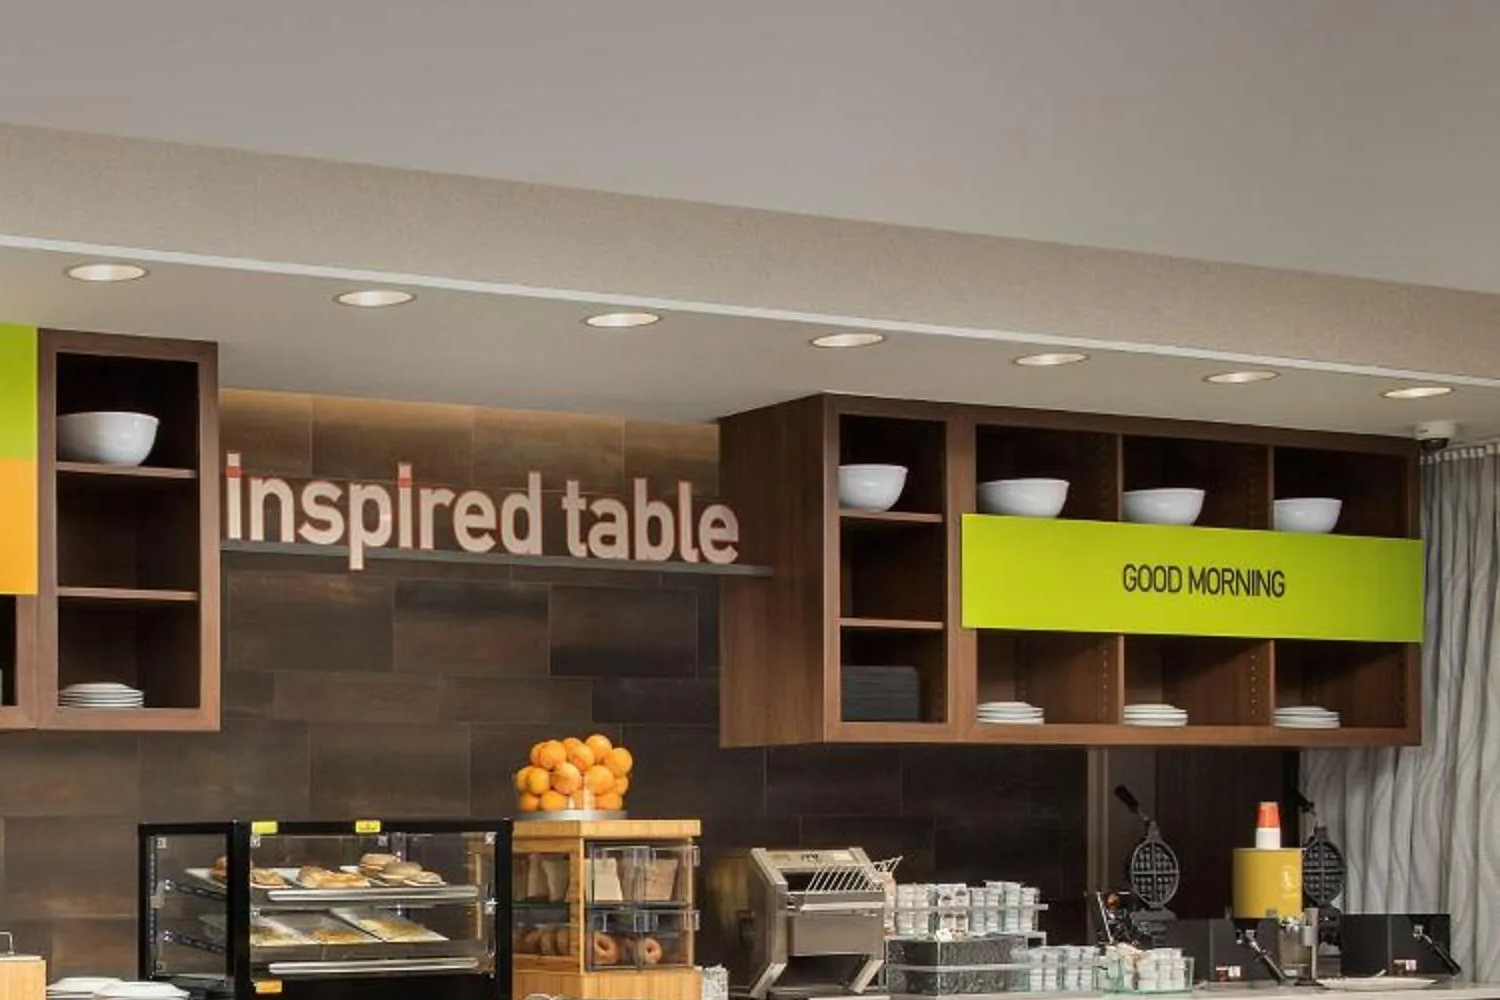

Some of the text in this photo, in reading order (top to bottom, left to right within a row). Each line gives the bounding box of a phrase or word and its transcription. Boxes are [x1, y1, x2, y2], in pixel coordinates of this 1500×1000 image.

[227, 452, 739, 570] inspired table
[1123, 563, 1286, 598] GOOD MORNING
